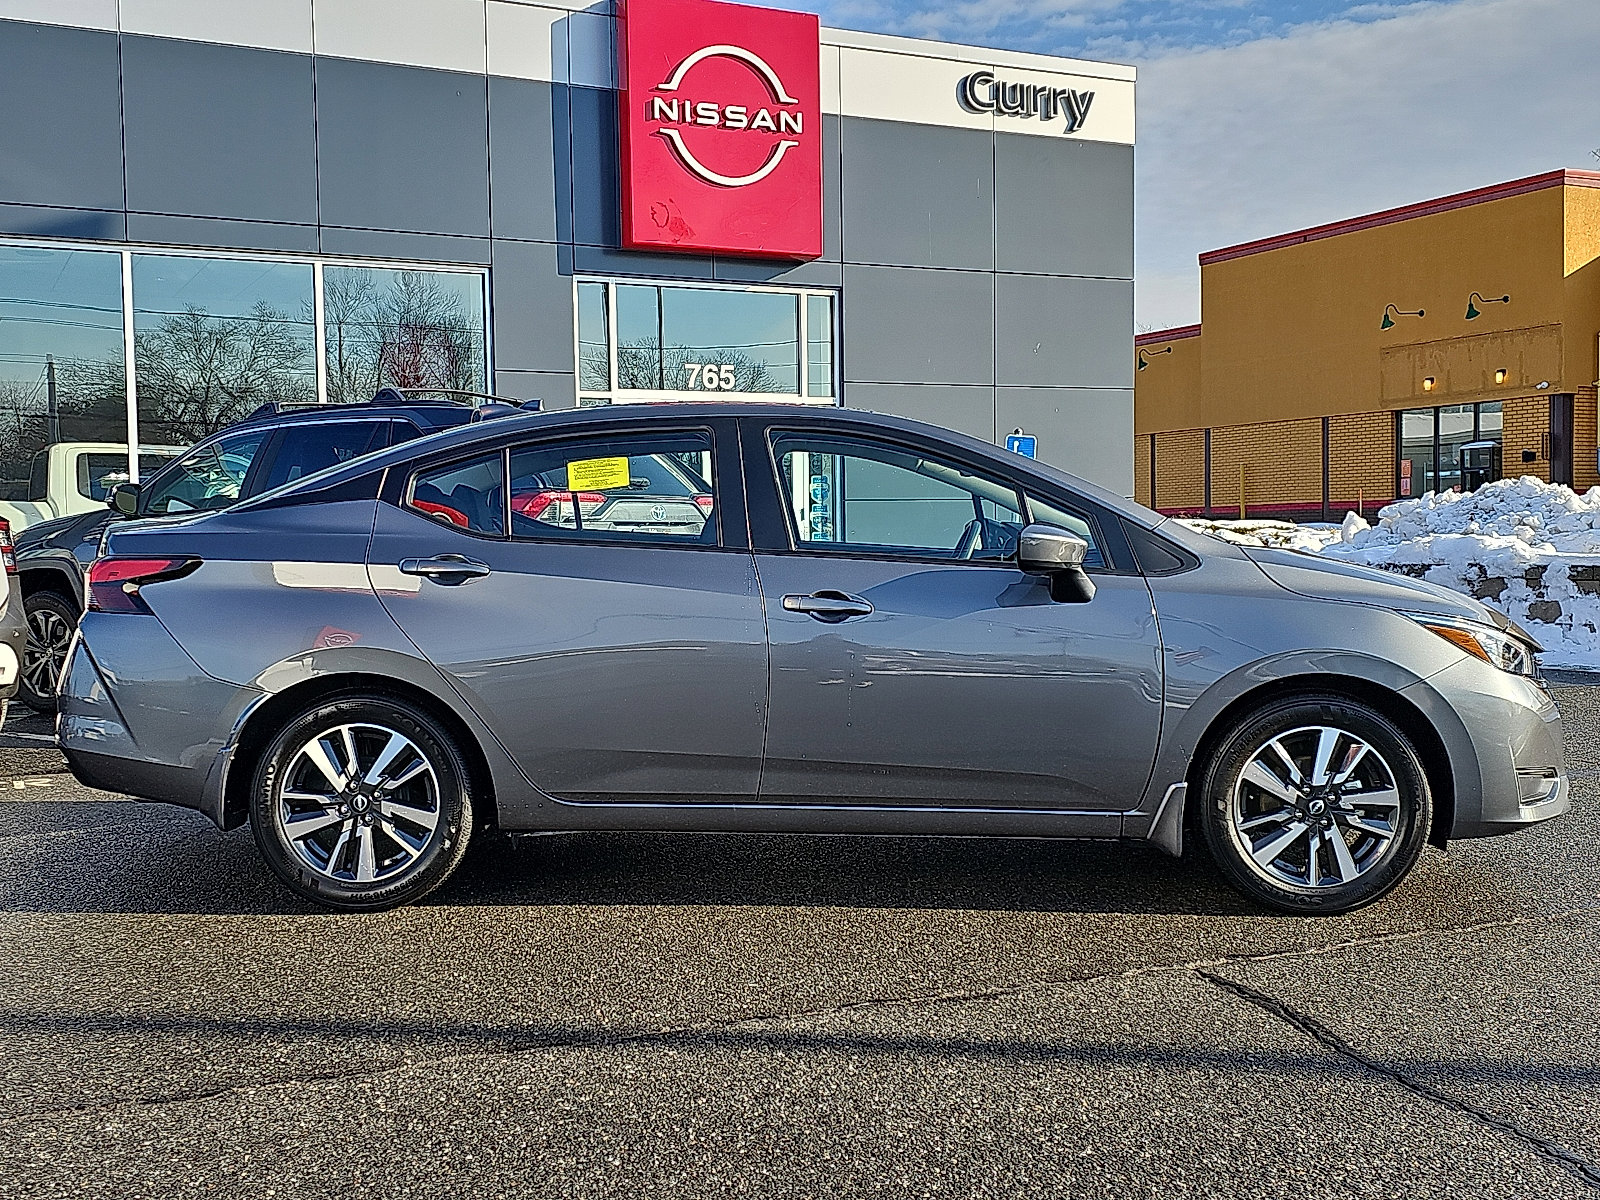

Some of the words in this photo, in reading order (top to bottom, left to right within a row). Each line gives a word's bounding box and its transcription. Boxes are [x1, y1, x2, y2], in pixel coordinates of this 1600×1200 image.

[647, 96, 803, 135] NISSAN
[957, 70, 1095, 133] Curry
[685, 363, 736, 390] 765
